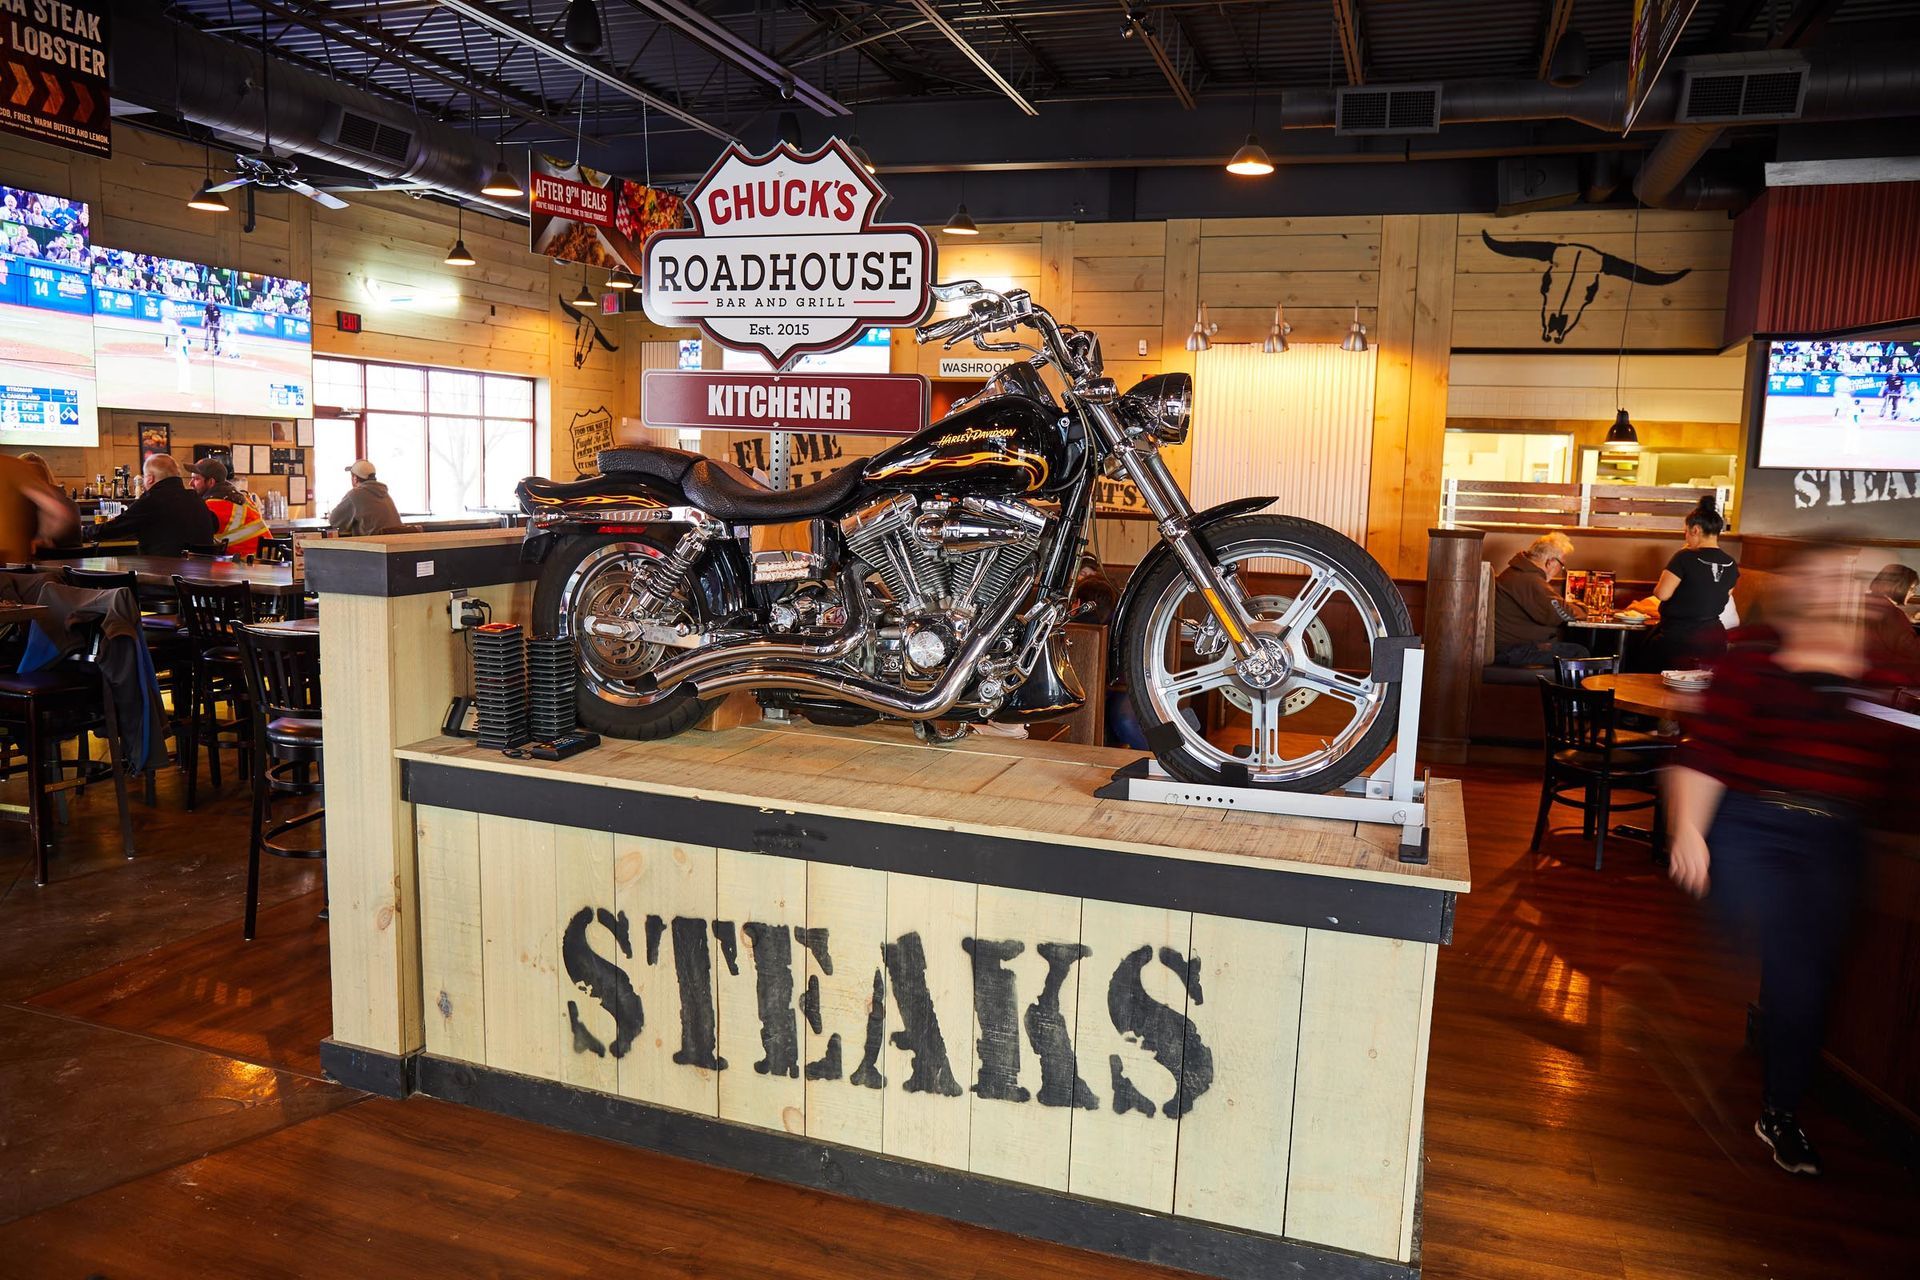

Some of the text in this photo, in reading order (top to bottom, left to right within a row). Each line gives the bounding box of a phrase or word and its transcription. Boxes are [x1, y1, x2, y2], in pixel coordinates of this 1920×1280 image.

[34, 0, 102, 43] STEAK
[12, 21, 106, 79] LOBSTER
[34, 117, 52, 129] WARM
[54, 122, 75, 135] BUTTER
[77, 129, 88, 139] AND
[535, 178, 564, 203] AFTER
[581, 189, 608, 212] DEALS
[708, 179, 858, 226] CHUCK'S
[29, 266, 54, 281] APRIL
[34, 281, 48, 296] 14
[658, 251, 913, 292] ROADHOUSE
[716, 297, 846, 308] BAR AND GRILL
[749, 323, 810, 336] Est. 2015
[21, 402, 55, 412] DET 0
[23, 413, 56, 423] TOR 0
[707, 384, 851, 421] KITCHENER
[733, 433, 843, 472] FLME
[938, 428, 1017, 446] HARLEY-DAVIDSON
[1794, 469, 1920, 509] STEA
[562, 906, 1214, 1119] STEAKS
